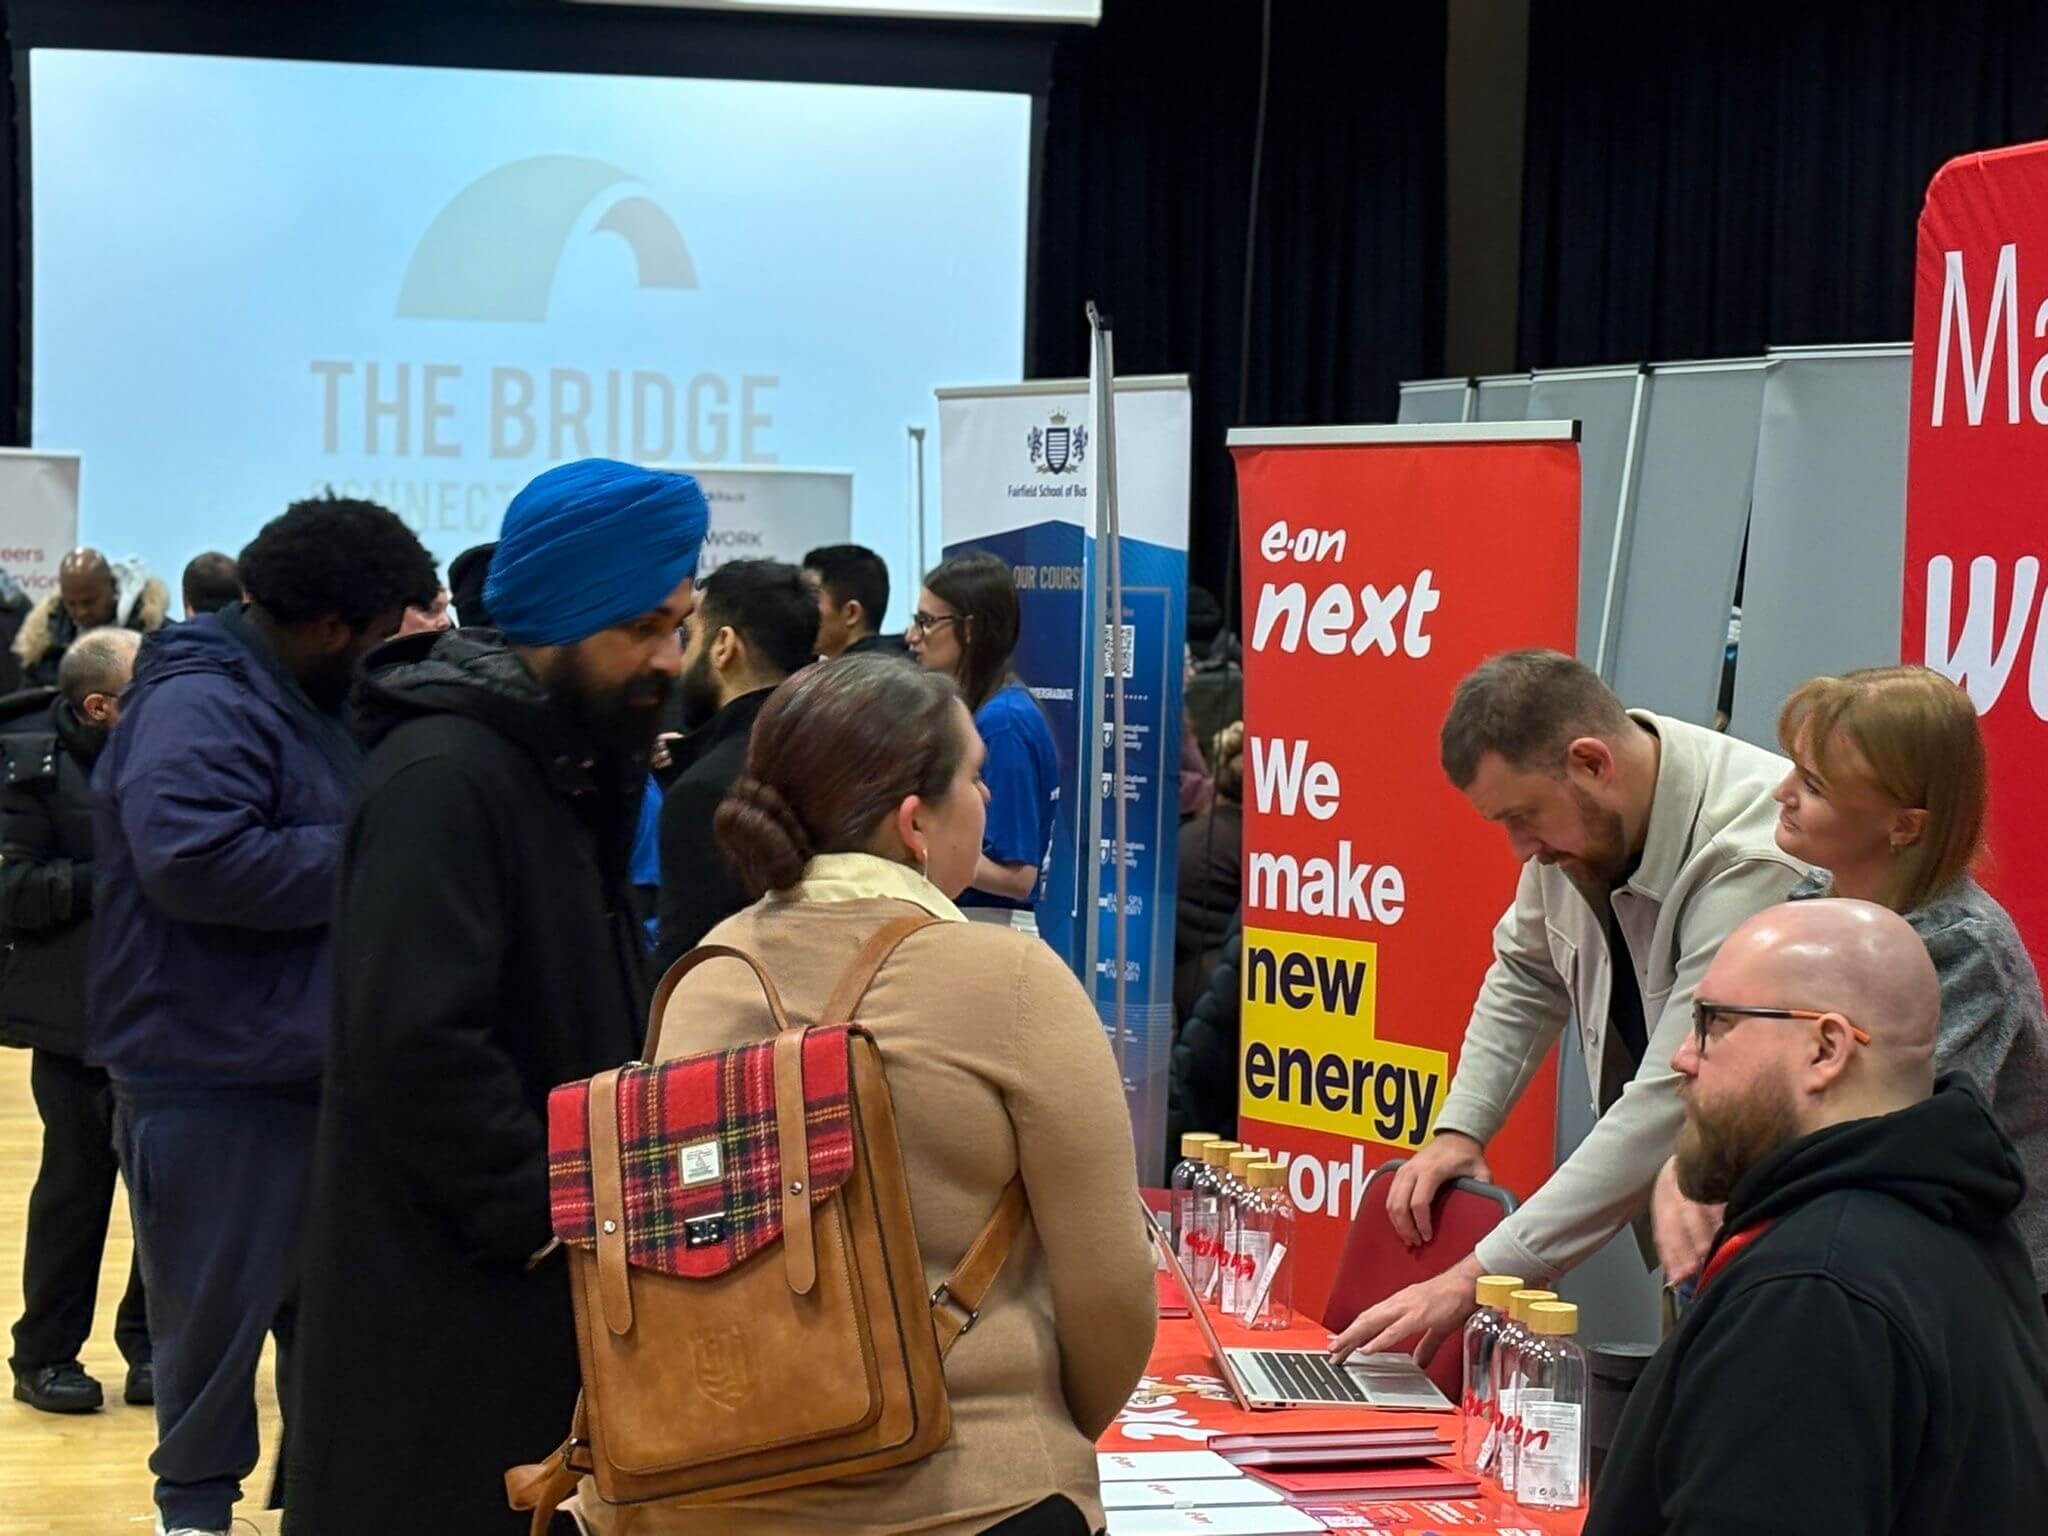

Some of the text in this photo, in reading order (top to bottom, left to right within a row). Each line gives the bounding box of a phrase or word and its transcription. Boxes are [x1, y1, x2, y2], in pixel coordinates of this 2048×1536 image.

[310, 360, 780, 465] THE BRIDGE
[1008, 484, 1037, 498] Fairfield
[1039, 484, 1063, 498] School
[1065, 484, 1073, 498] of
[1013, 565, 1036, 589] OUR
[1251, 568, 1441, 659] next
[1250, 735, 1341, 820] We
[1248, 839, 1406, 926] make
[1247, 945, 1367, 1017] new
[1245, 1040, 1440, 1146] energy
